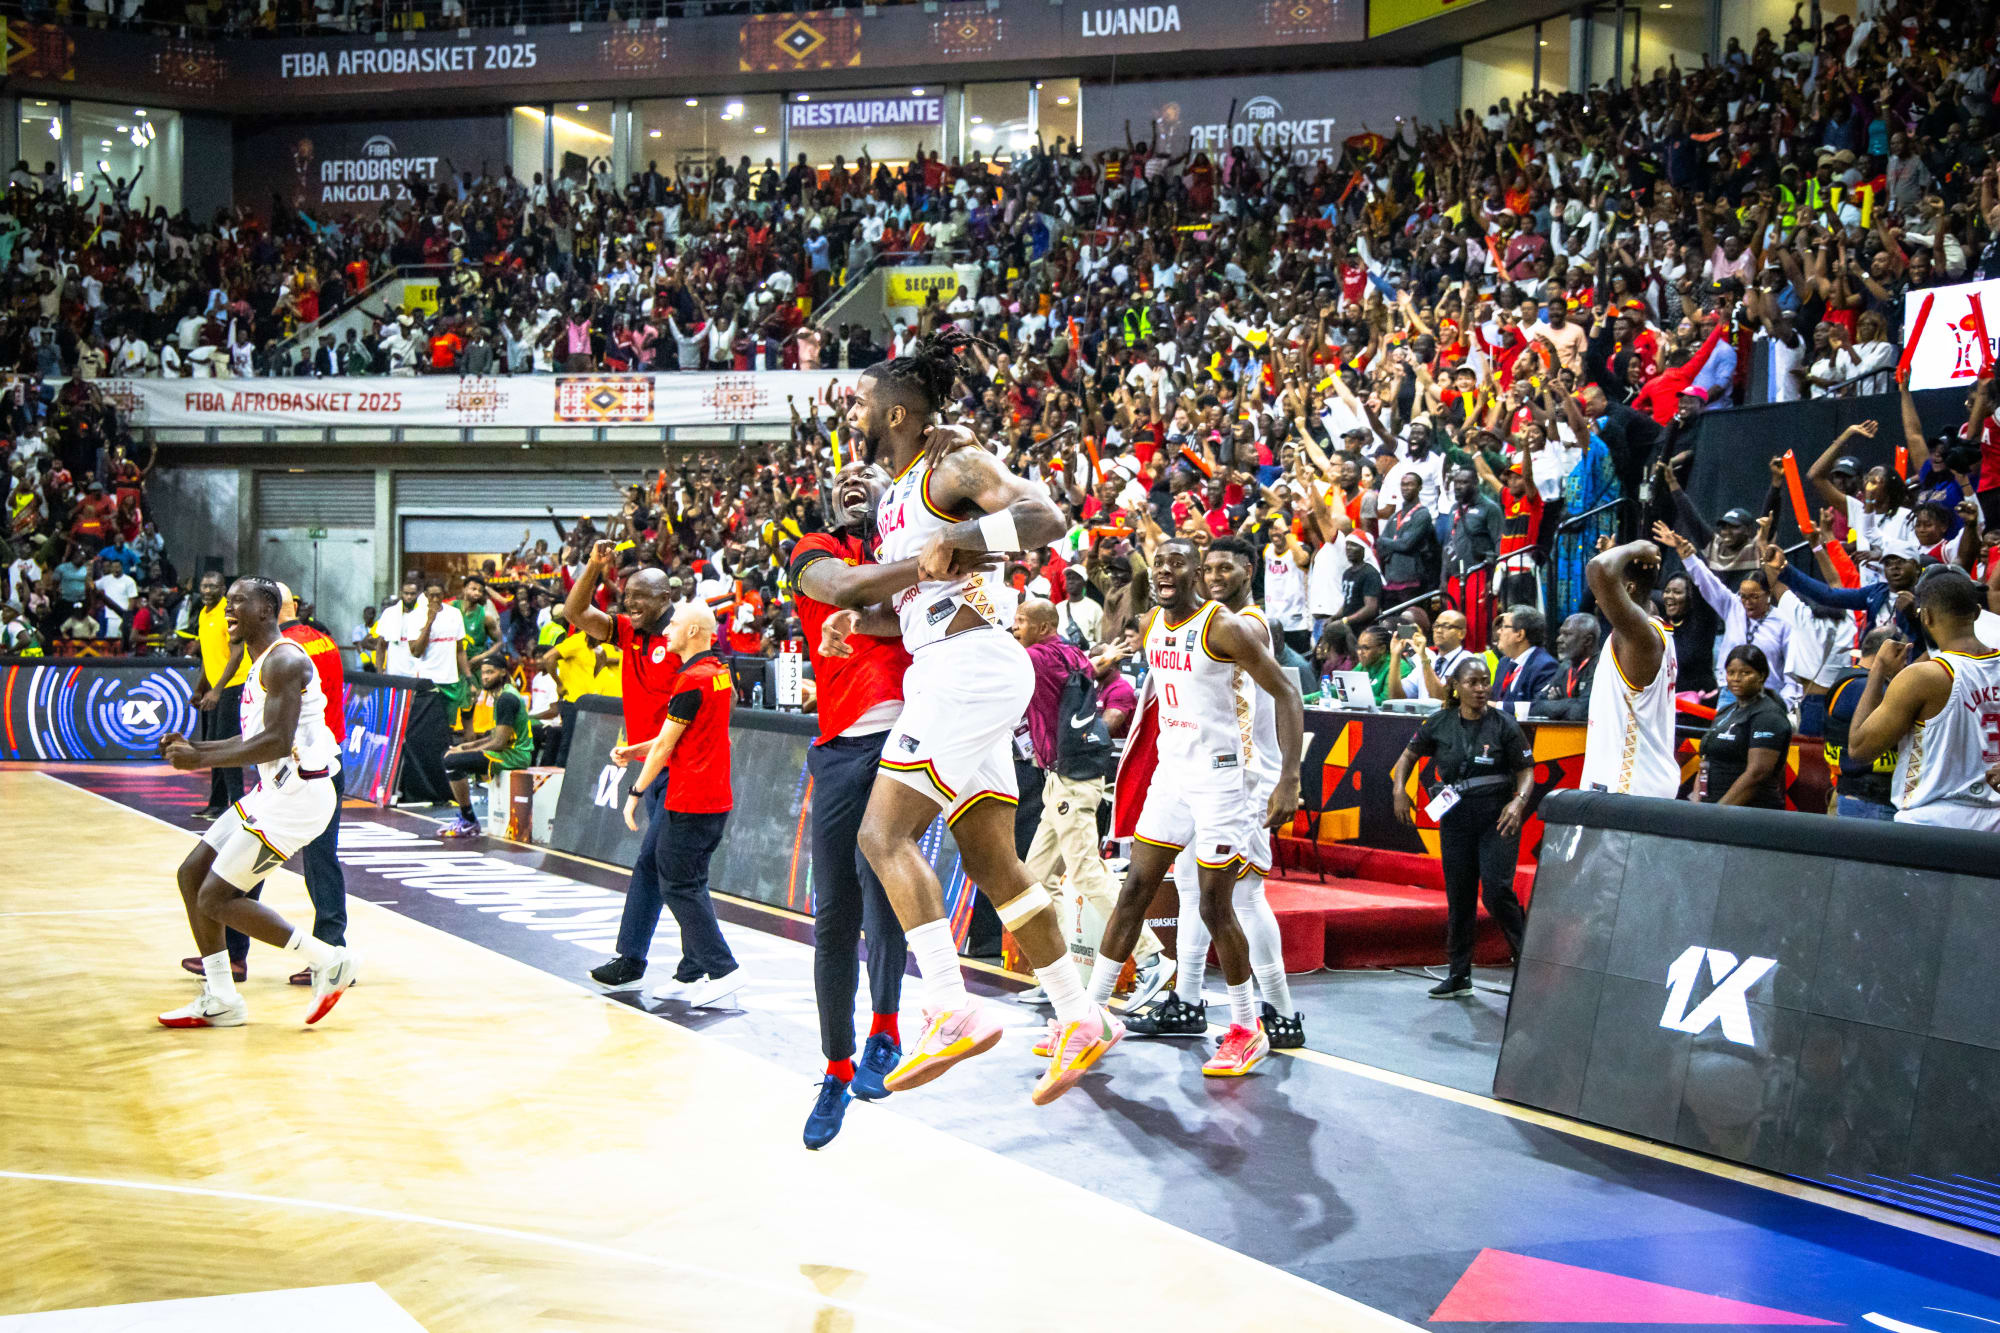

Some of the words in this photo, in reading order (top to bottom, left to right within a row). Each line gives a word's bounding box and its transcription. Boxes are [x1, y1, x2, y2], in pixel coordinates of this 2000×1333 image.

[1082, 5, 1181, 37] LUANDA
[281, 52, 330, 78] FIBA
[337, 46, 477, 76] AFROBASKET
[484, 43, 537, 70] 2025
[792, 99, 939, 126] RESTAURANTE
[1248, 105, 1275, 119] FIBA
[368, 144, 390, 157] FIBA
[322, 184, 391, 203] ANGOLA
[905, 277, 955, 292] SECTOR
[185, 392, 225, 411] FIBA
[231, 392, 352, 411] AFROBASKET
[357, 392, 402, 411] 2025
[789, 640, 797, 652] 5
[790, 654, 796, 664] 4
[1150, 649, 1192, 672] ANGOLA
[790, 667, 796, 678] 3
[790, 680, 796, 691] 2
[790, 693, 795, 703] 1
[1165, 683, 1178, 708] 0
[1964, 686, 2000, 712] LUKE
[122, 700, 163, 725] 1X
[594, 764, 627, 809] 1X
[1659, 945, 1778, 1047] 1X
